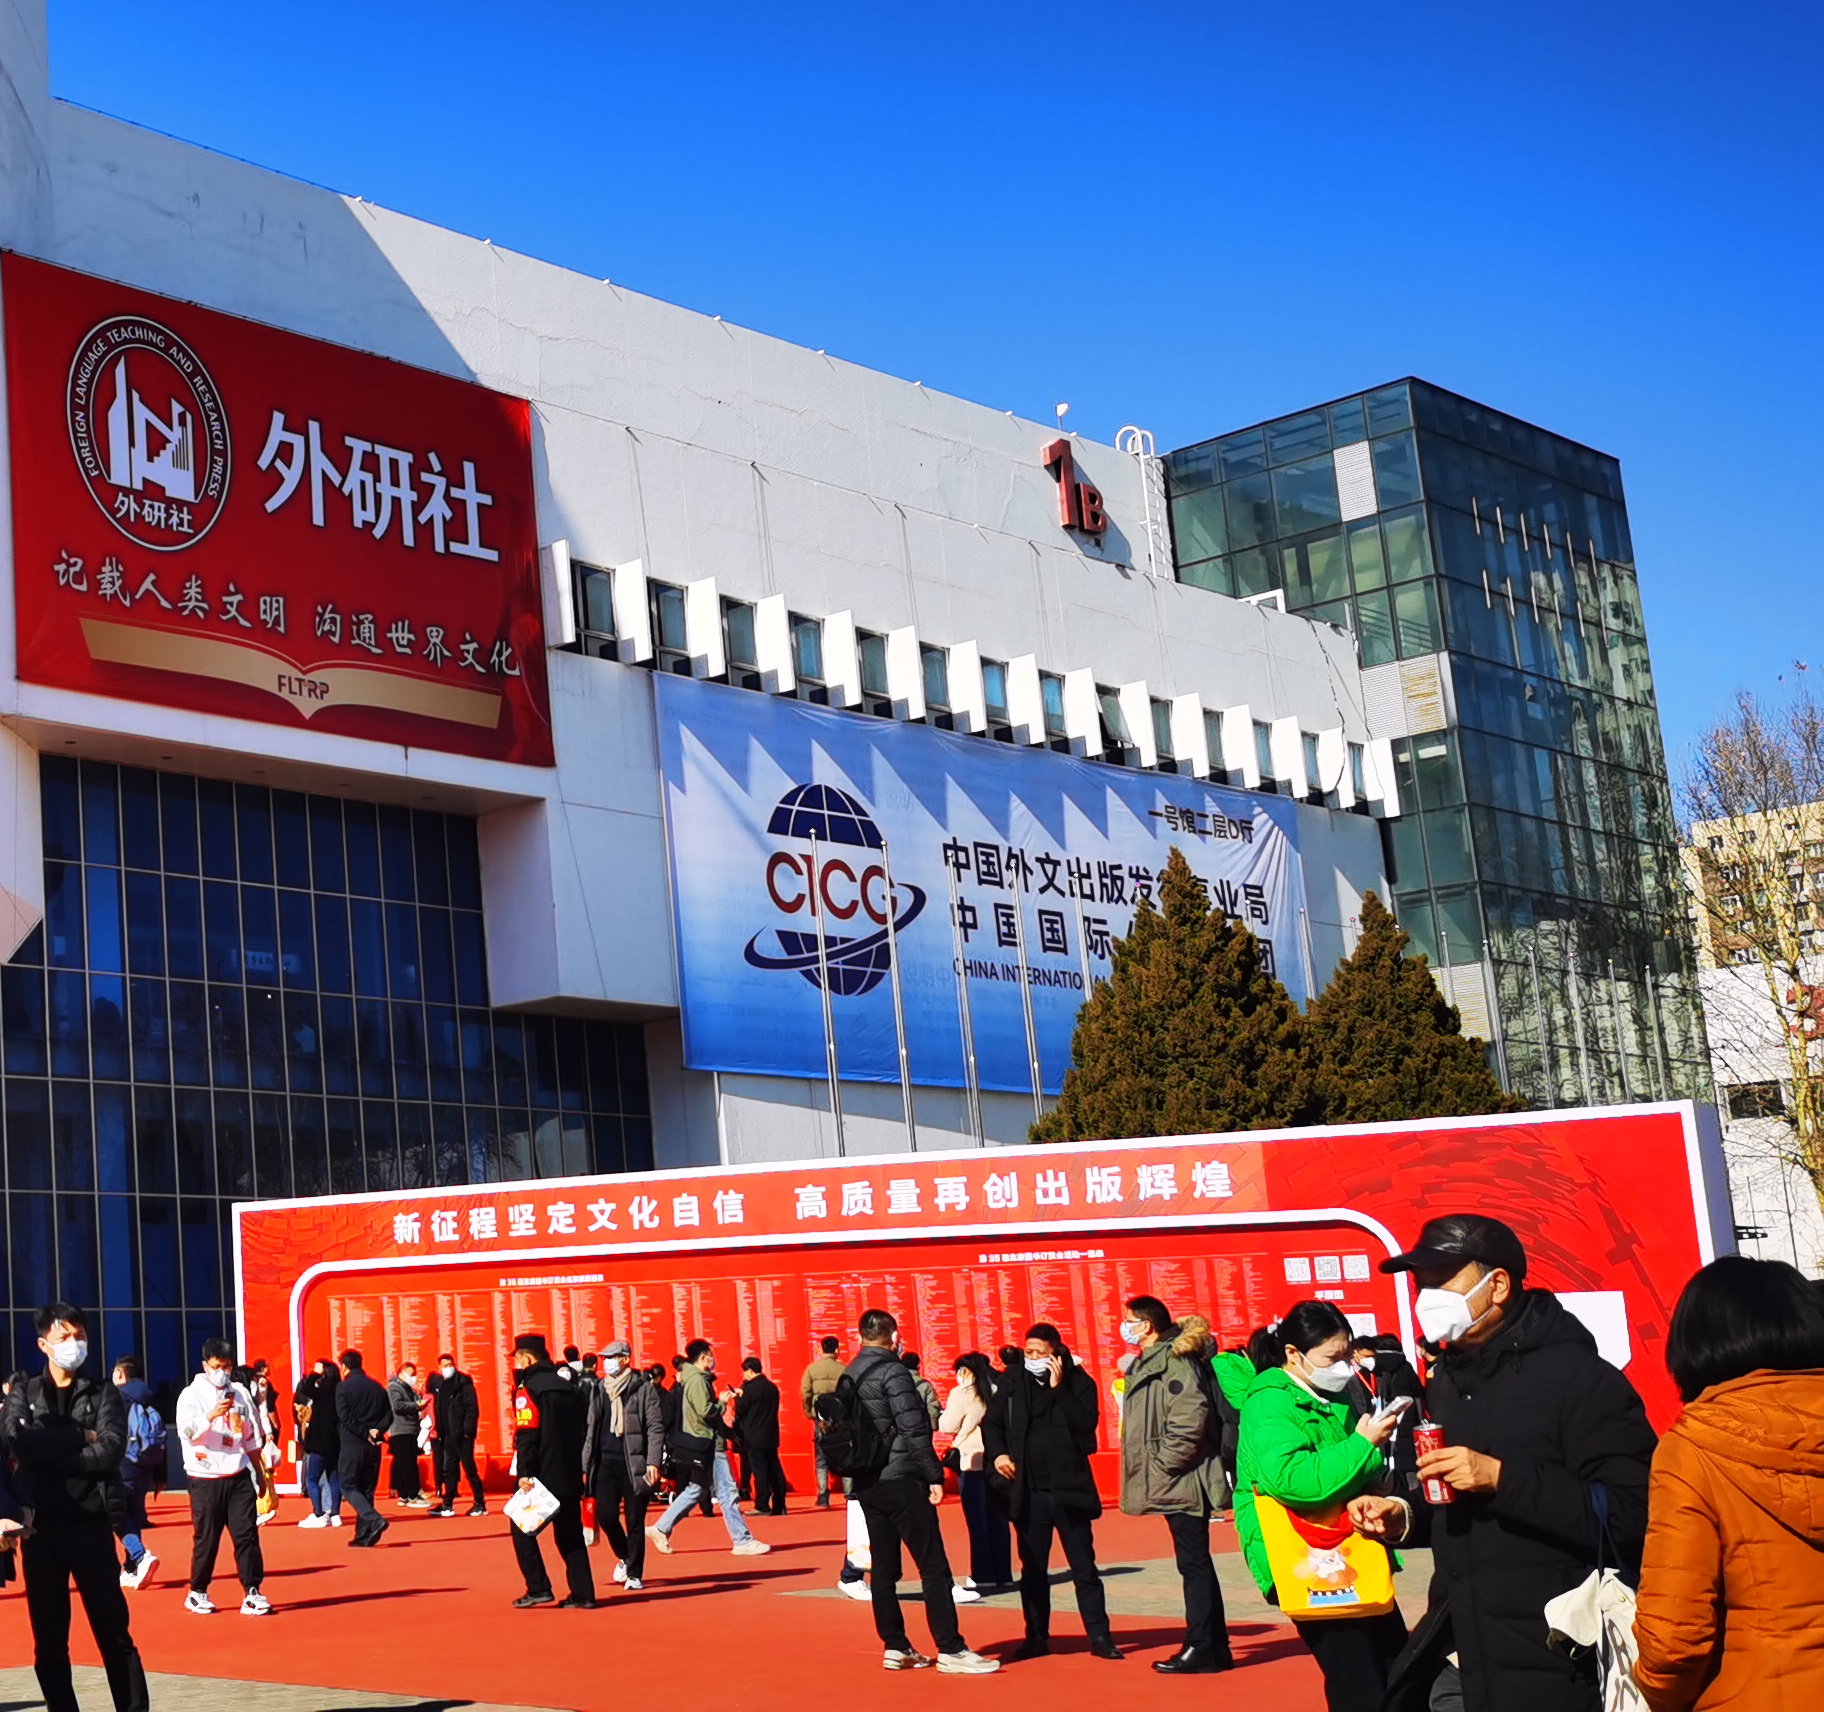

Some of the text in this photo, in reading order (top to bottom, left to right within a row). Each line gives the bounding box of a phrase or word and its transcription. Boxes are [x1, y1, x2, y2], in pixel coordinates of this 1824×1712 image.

[74, 326, 224, 499] FOREIGN LANGUAGE TEACHING AND RESEARCH PRESS
[114, 491, 194, 534] 外研社
[256, 410, 500, 562] 外研社
[1040, 438, 1107, 533] 1B
[52, 550, 521, 678] 记载人类文明 沟通世界文化
[277, 674, 330, 700] FLTRP
[1148, 805, 1254, 844] 一号馆二层D厅
[953, 958, 1106, 991] CHINA INTERNATIO
[392, 1160, 1234, 1245] 新征程坚定文化自信 高质量再创出版辉煌
